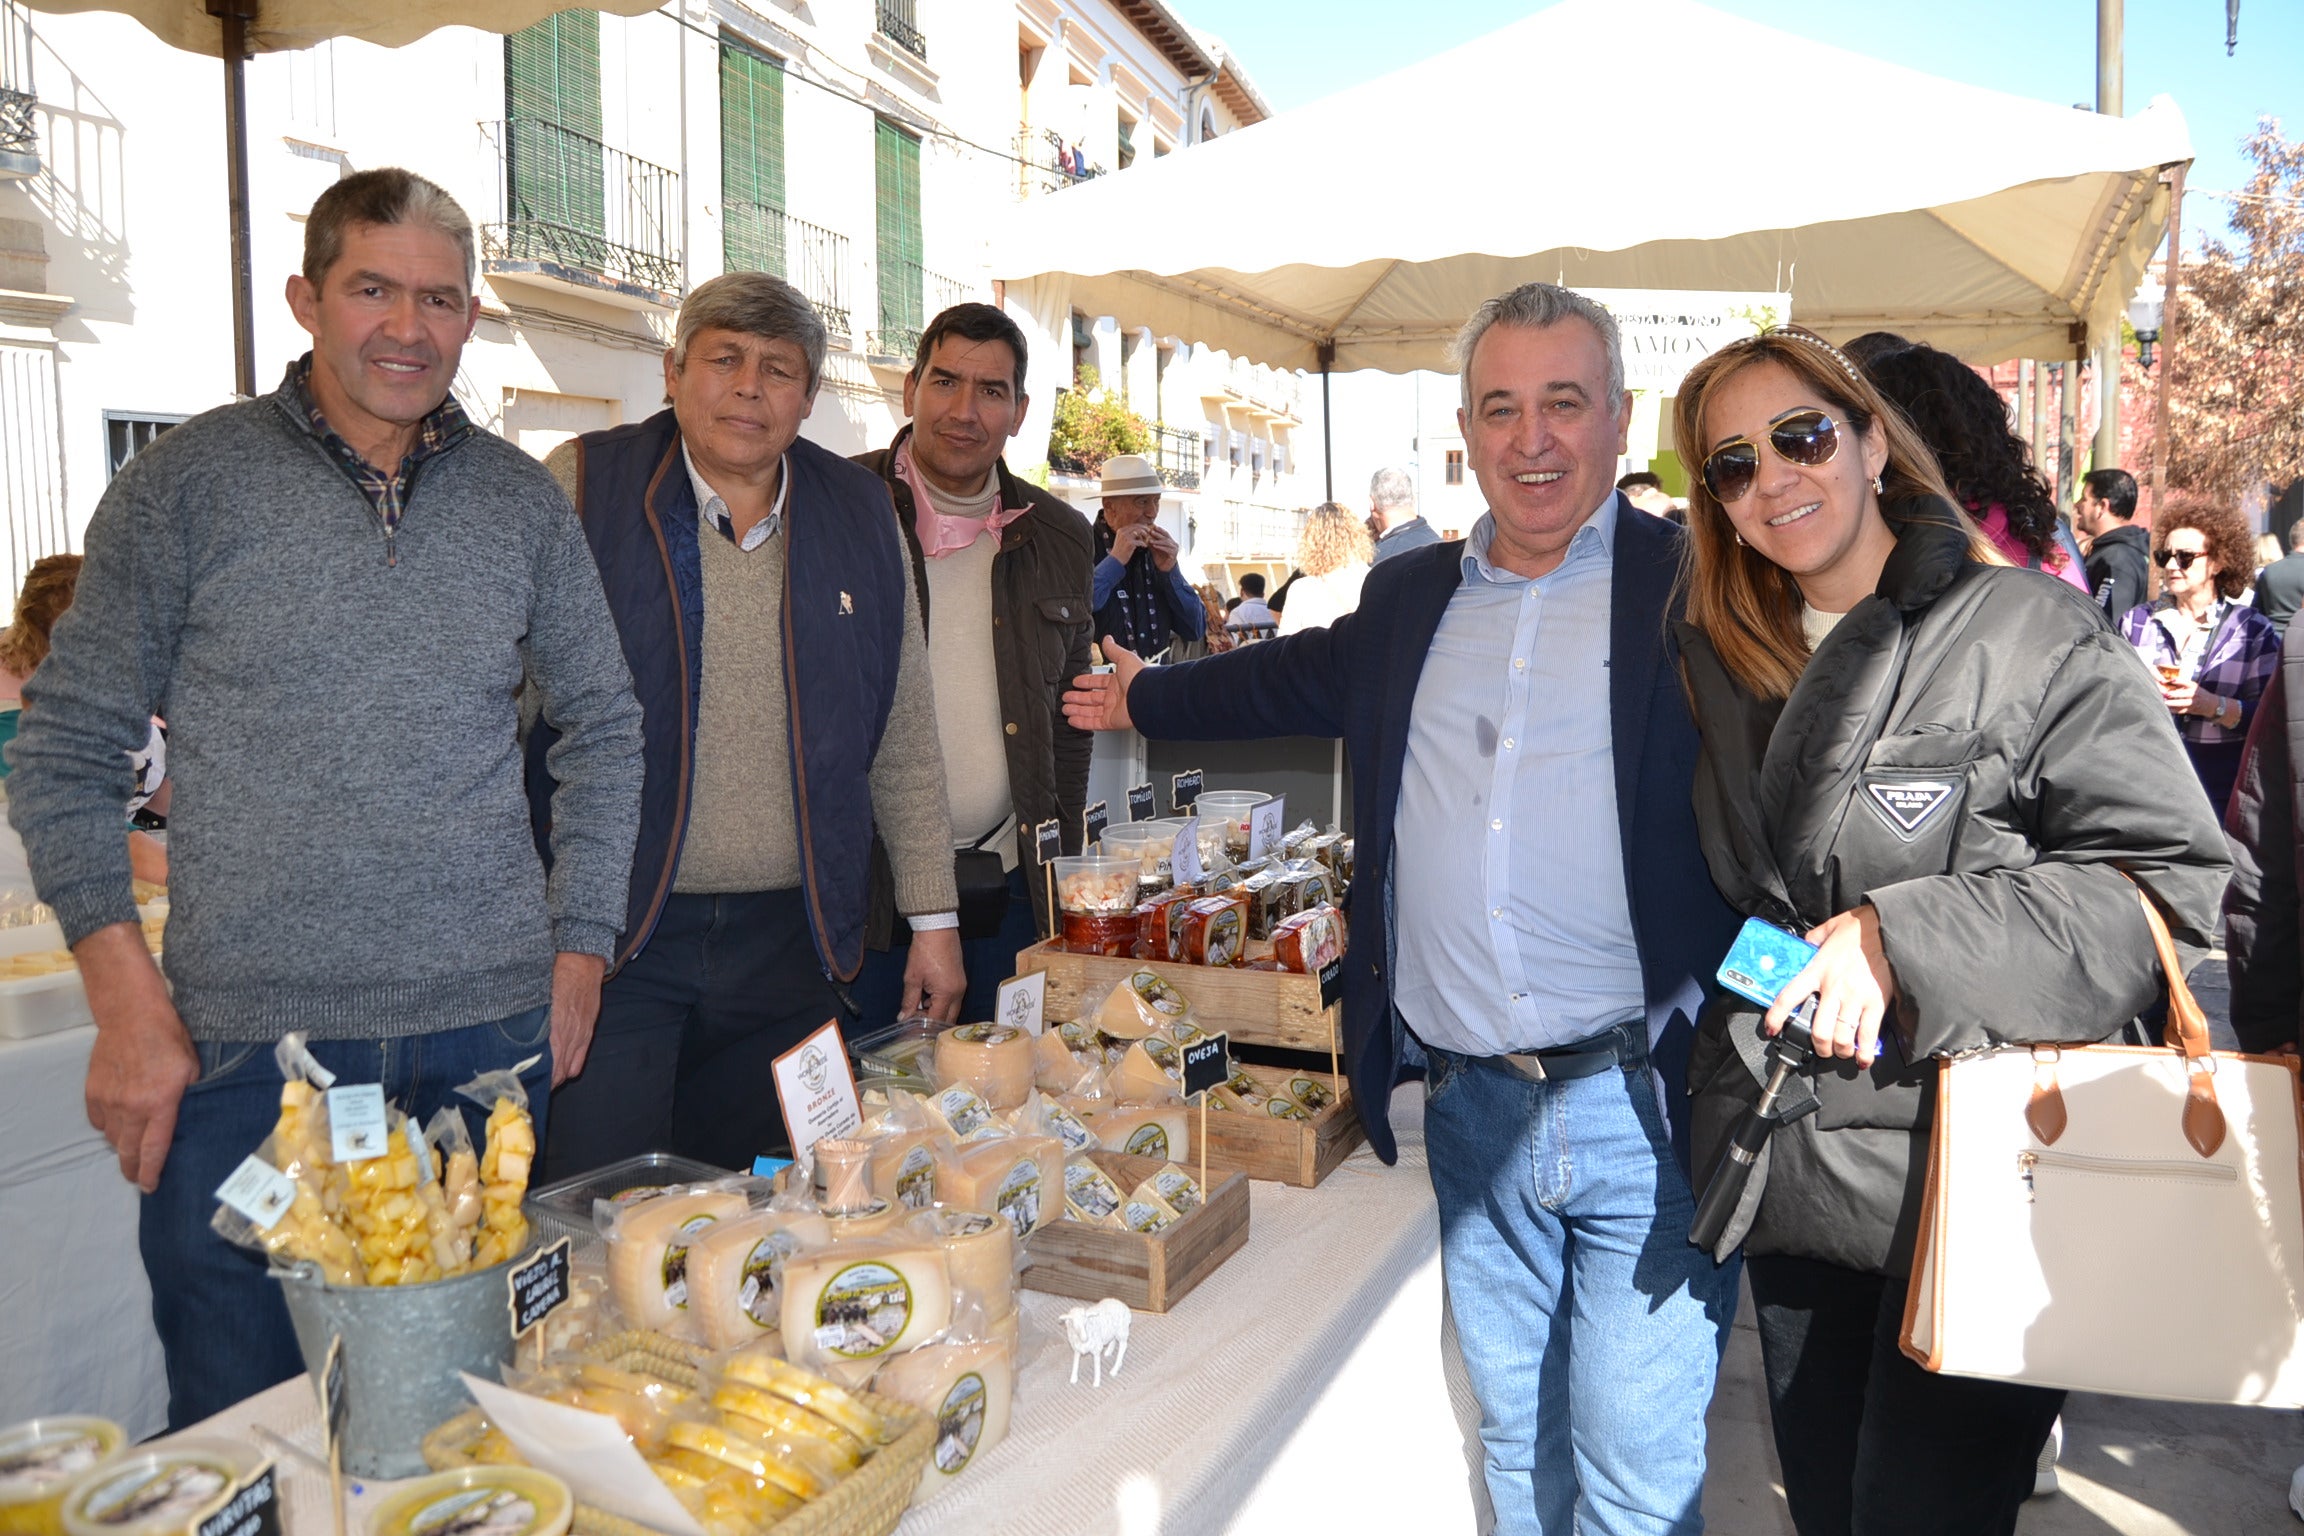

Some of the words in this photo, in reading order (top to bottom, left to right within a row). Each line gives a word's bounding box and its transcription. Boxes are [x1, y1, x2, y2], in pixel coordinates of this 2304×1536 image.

[1625, 335, 1709, 354] AMON
[1176, 775, 1201, 789] ROMERO
[1886, 791, 1933, 801] PRADA
[1321, 964, 1339, 984] CURADO
[1187, 1043, 1219, 1065] OVEJA
[807, 1087, 836, 1113] BRONZE
